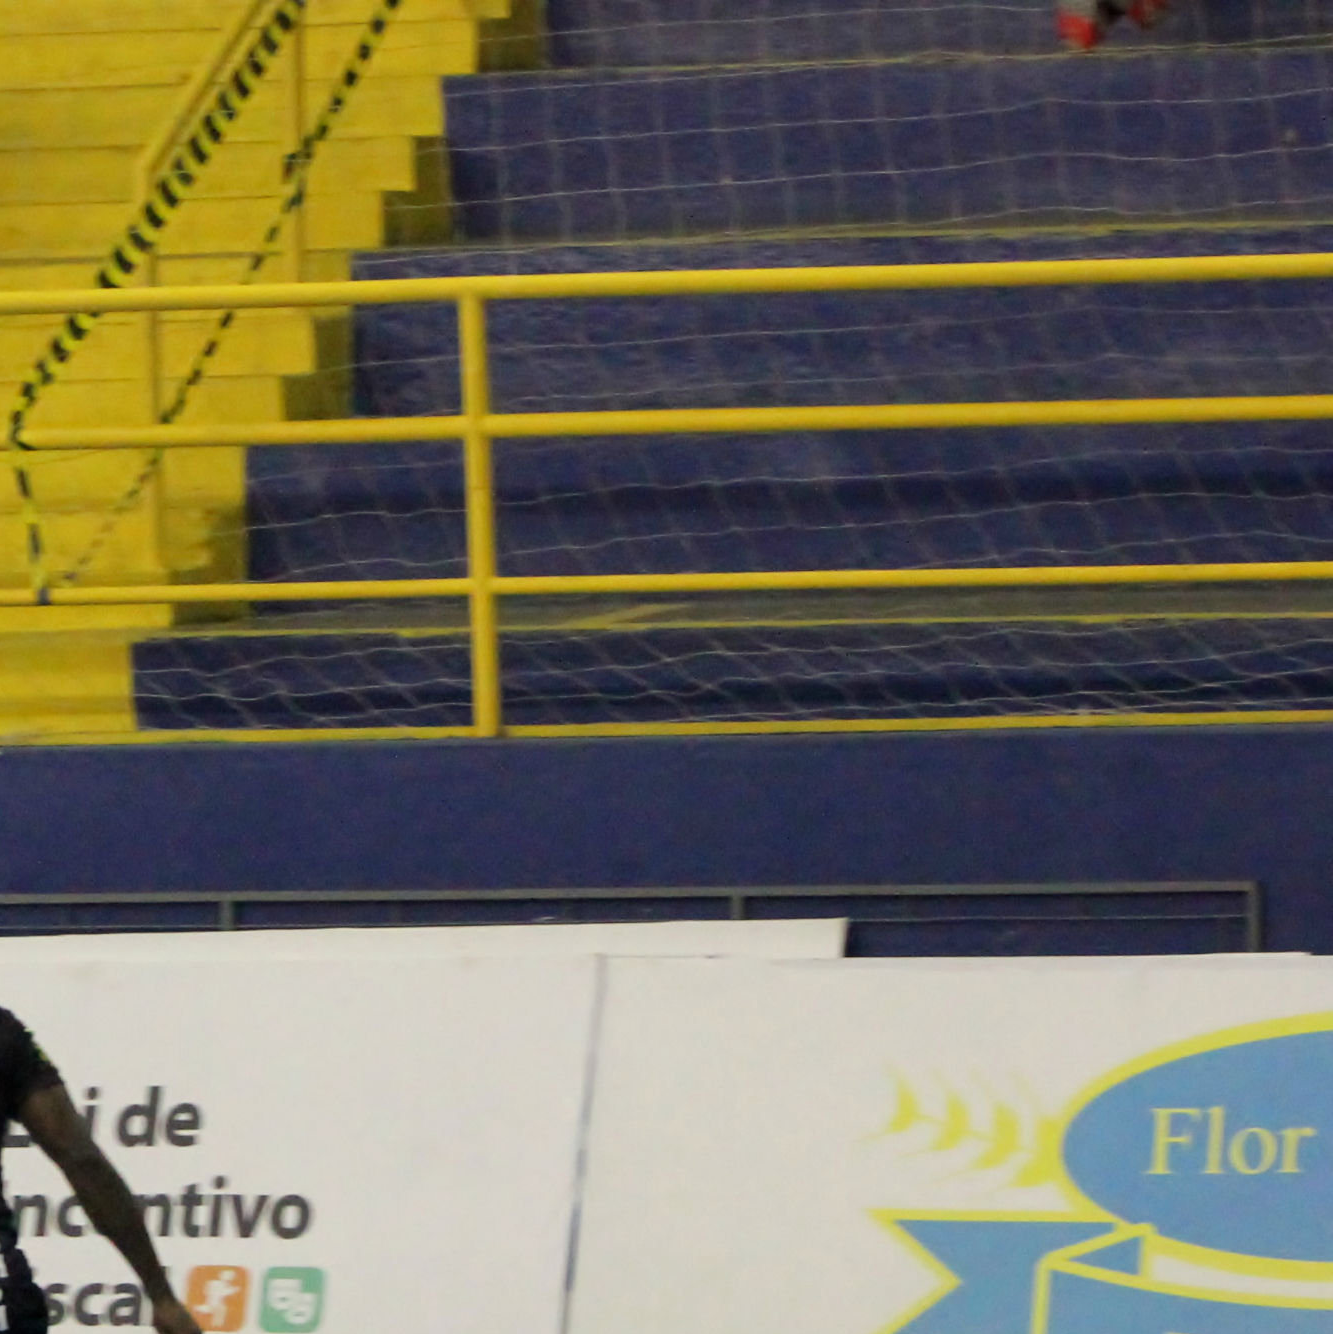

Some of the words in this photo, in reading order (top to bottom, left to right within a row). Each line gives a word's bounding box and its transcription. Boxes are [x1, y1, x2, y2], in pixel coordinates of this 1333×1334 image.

[117, 1084, 203, 1149] de
[1142, 1105, 1317, 1175] Flor
[12, 1175, 312, 1240] ncntivo
